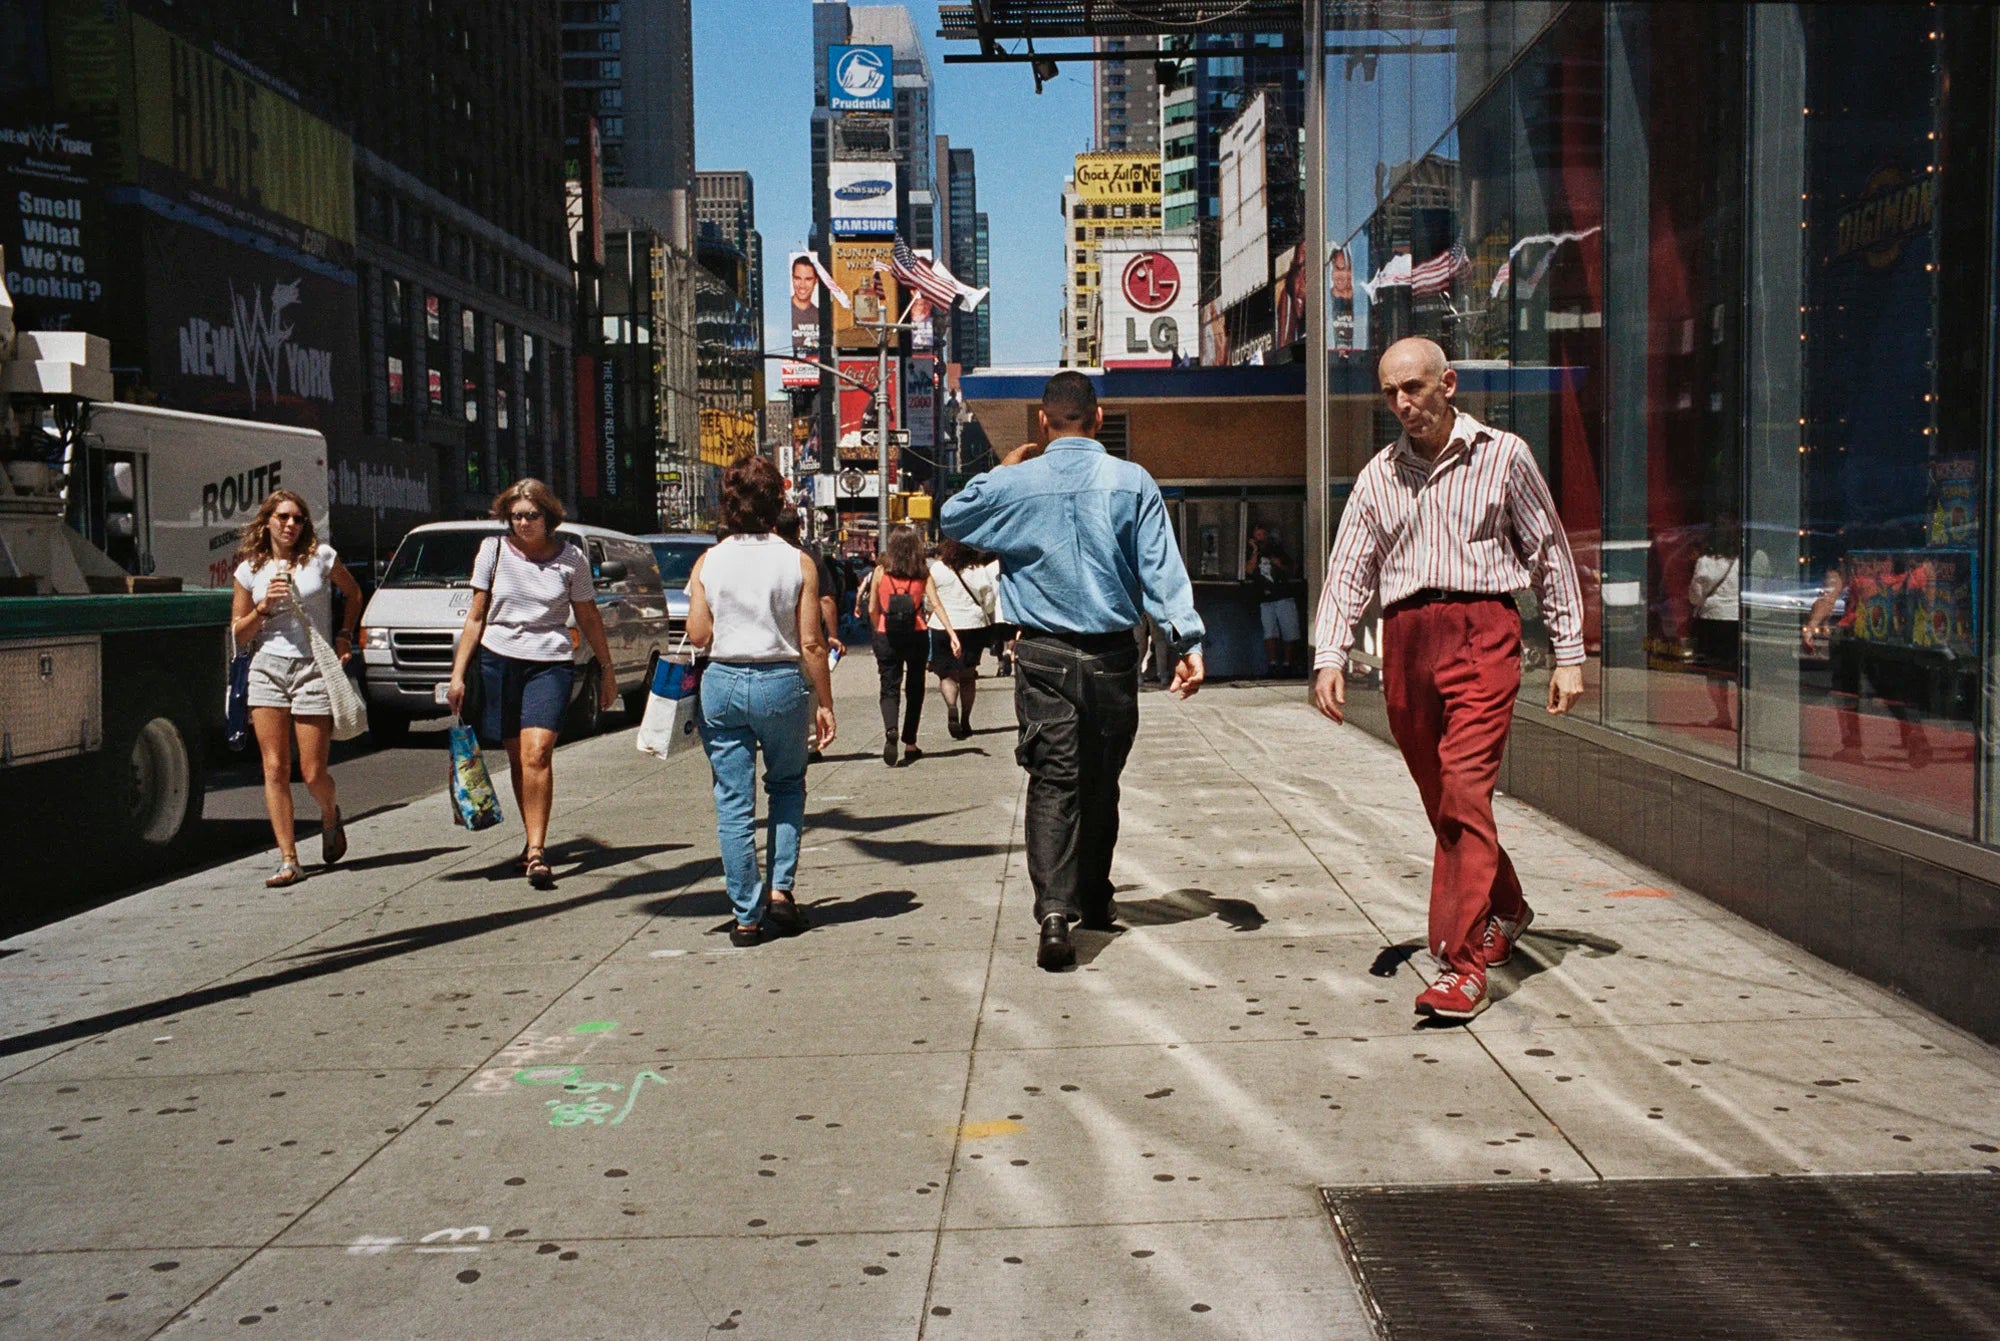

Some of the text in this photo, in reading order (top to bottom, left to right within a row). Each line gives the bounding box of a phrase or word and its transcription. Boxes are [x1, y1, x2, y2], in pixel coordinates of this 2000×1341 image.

[832, 97, 890, 109] Prudential
[1078, 164, 1108, 185] Chock
[18, 190, 82, 221] Smell
[841, 186, 887, 196] SAMSUNG
[21, 218, 81, 247] What
[834, 219, 894, 231] SAMSUNG
[1838, 180, 1932, 254] DIGIMON
[19, 245, 86, 274] We're
[6, 271, 102, 302] Cookin'?
[1126, 316, 1179, 353] LG
[179, 317, 236, 384] NEW
[285, 342, 335, 403] YORK
[601, 360, 617, 496] THE RIGHT RELATIONSHIP
[203, 460, 282, 527] ROUTE
[339, 458, 358, 506] the
